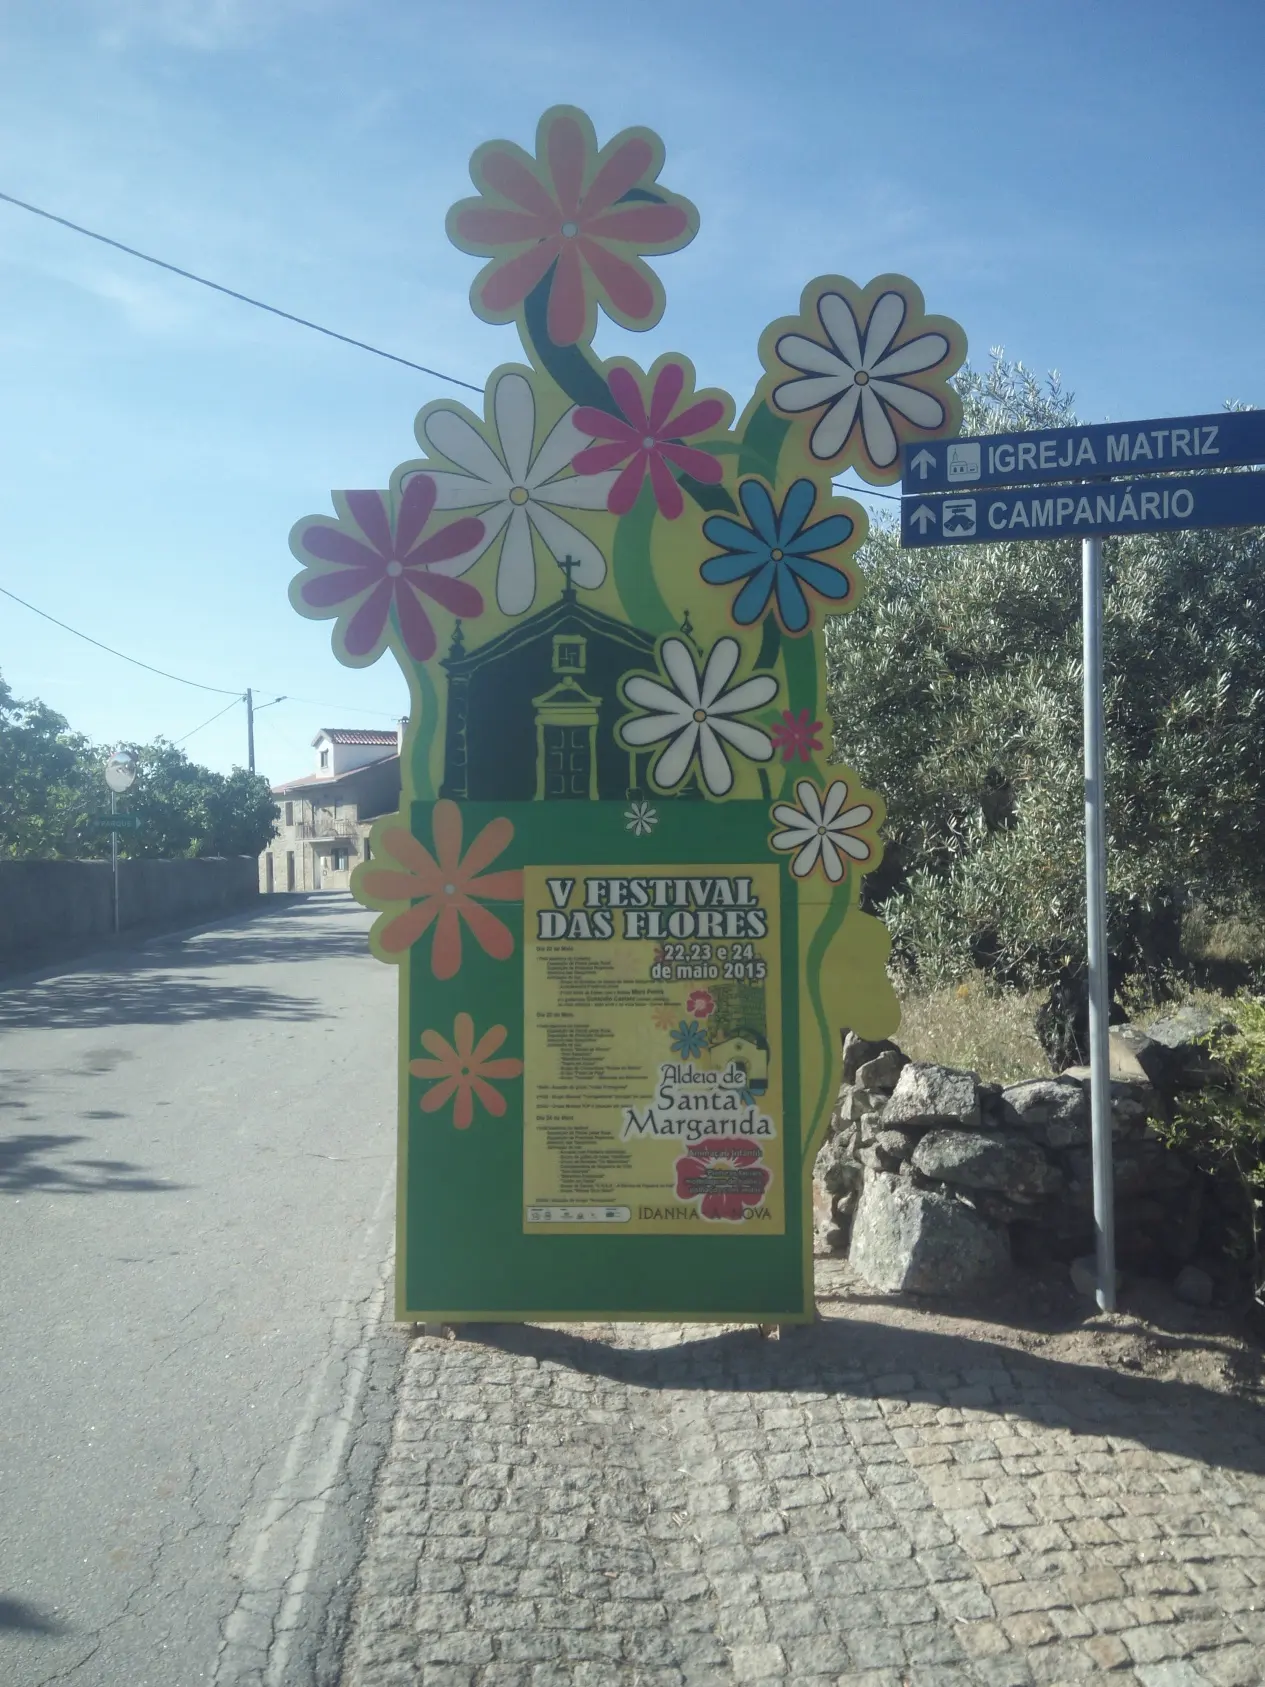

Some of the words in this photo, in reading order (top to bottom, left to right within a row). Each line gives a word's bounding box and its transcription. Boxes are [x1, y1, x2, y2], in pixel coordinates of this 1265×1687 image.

[988, 438, 1098, 473] IGREJA
[1106, 426, 1220, 463] MATRIZ
[988, 486, 1195, 530] CAMPANÁRIO
[100, 820, 132, 828] PARQUE
[547, 878, 575, 908] V
[584, 877, 759, 908] FESTIVAL
[537, 911, 614, 940] DAS
[623, 908, 768, 939] FLORES
[664, 944, 711, 961] 22,23
[717, 947, 727, 960] e
[732, 944, 754, 960] 24
[652, 963, 671, 978] de
[677, 963, 718, 978] maio
[724, 962, 766, 978] 2015
[661, 1063, 717, 1084] Aldeia
[723, 1065, 744, 1083] de
[657, 1085, 738, 1111] Santa
[624, 1109, 771, 1140] Margarida
[638, 1206, 699, 1220] IDANHA
